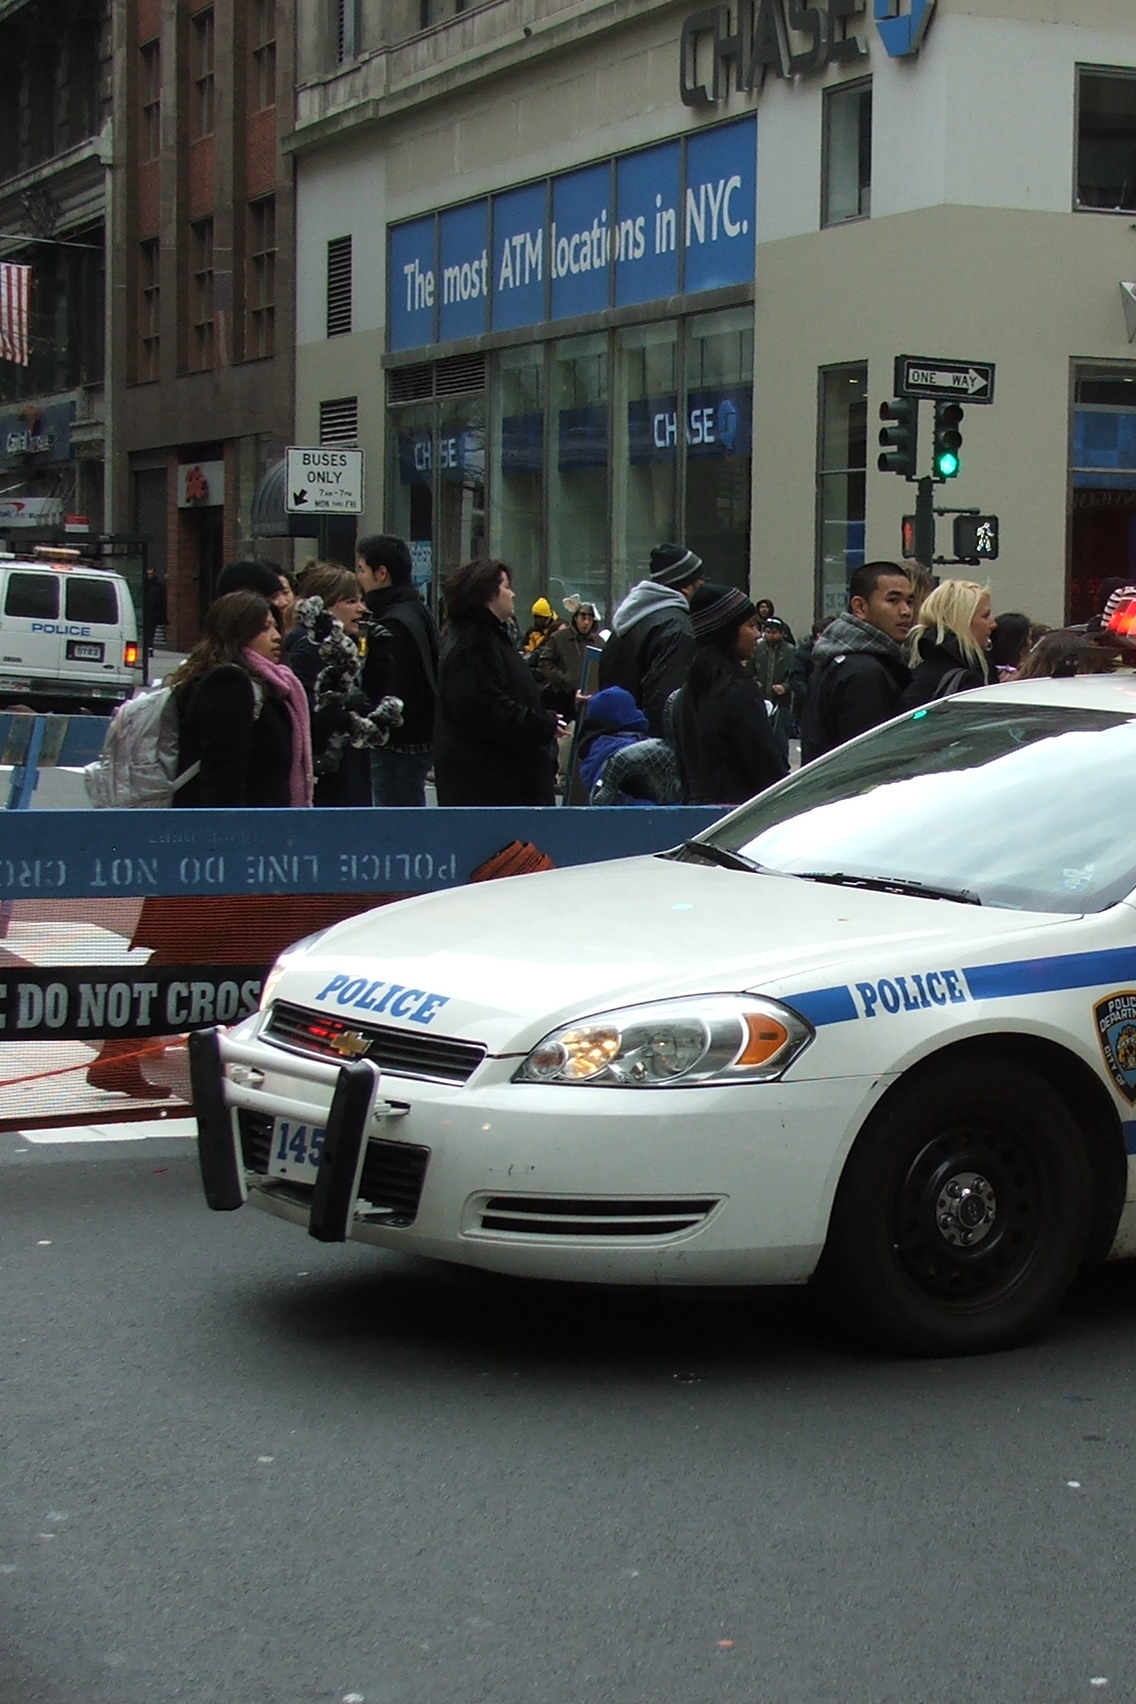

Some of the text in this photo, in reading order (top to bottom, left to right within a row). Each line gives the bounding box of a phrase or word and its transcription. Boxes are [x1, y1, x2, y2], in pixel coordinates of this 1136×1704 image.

[680, 0, 867, 106] CHASE
[404, 175, 749, 311] The most ATM locations in NYC.
[912, 371, 977, 387] ONE WAY
[303, 453, 347, 466] BUSES
[414, 438, 457, 471] CHSE
[307, 471, 342, 483] ONLY
[32, 623, 91, 636] POLICE
[0, 854, 456, 887] POLICE LINE DO NOT CRO
[17, 982, 69, 1029] DO
[77, 981, 158, 1028] NOT
[167, 980, 261, 1025] CROS
[315, 974, 451, 1025] POLICE
[855, 969, 967, 1018] POLICE
[1104, 1045, 1126, 1087] CITY OF
